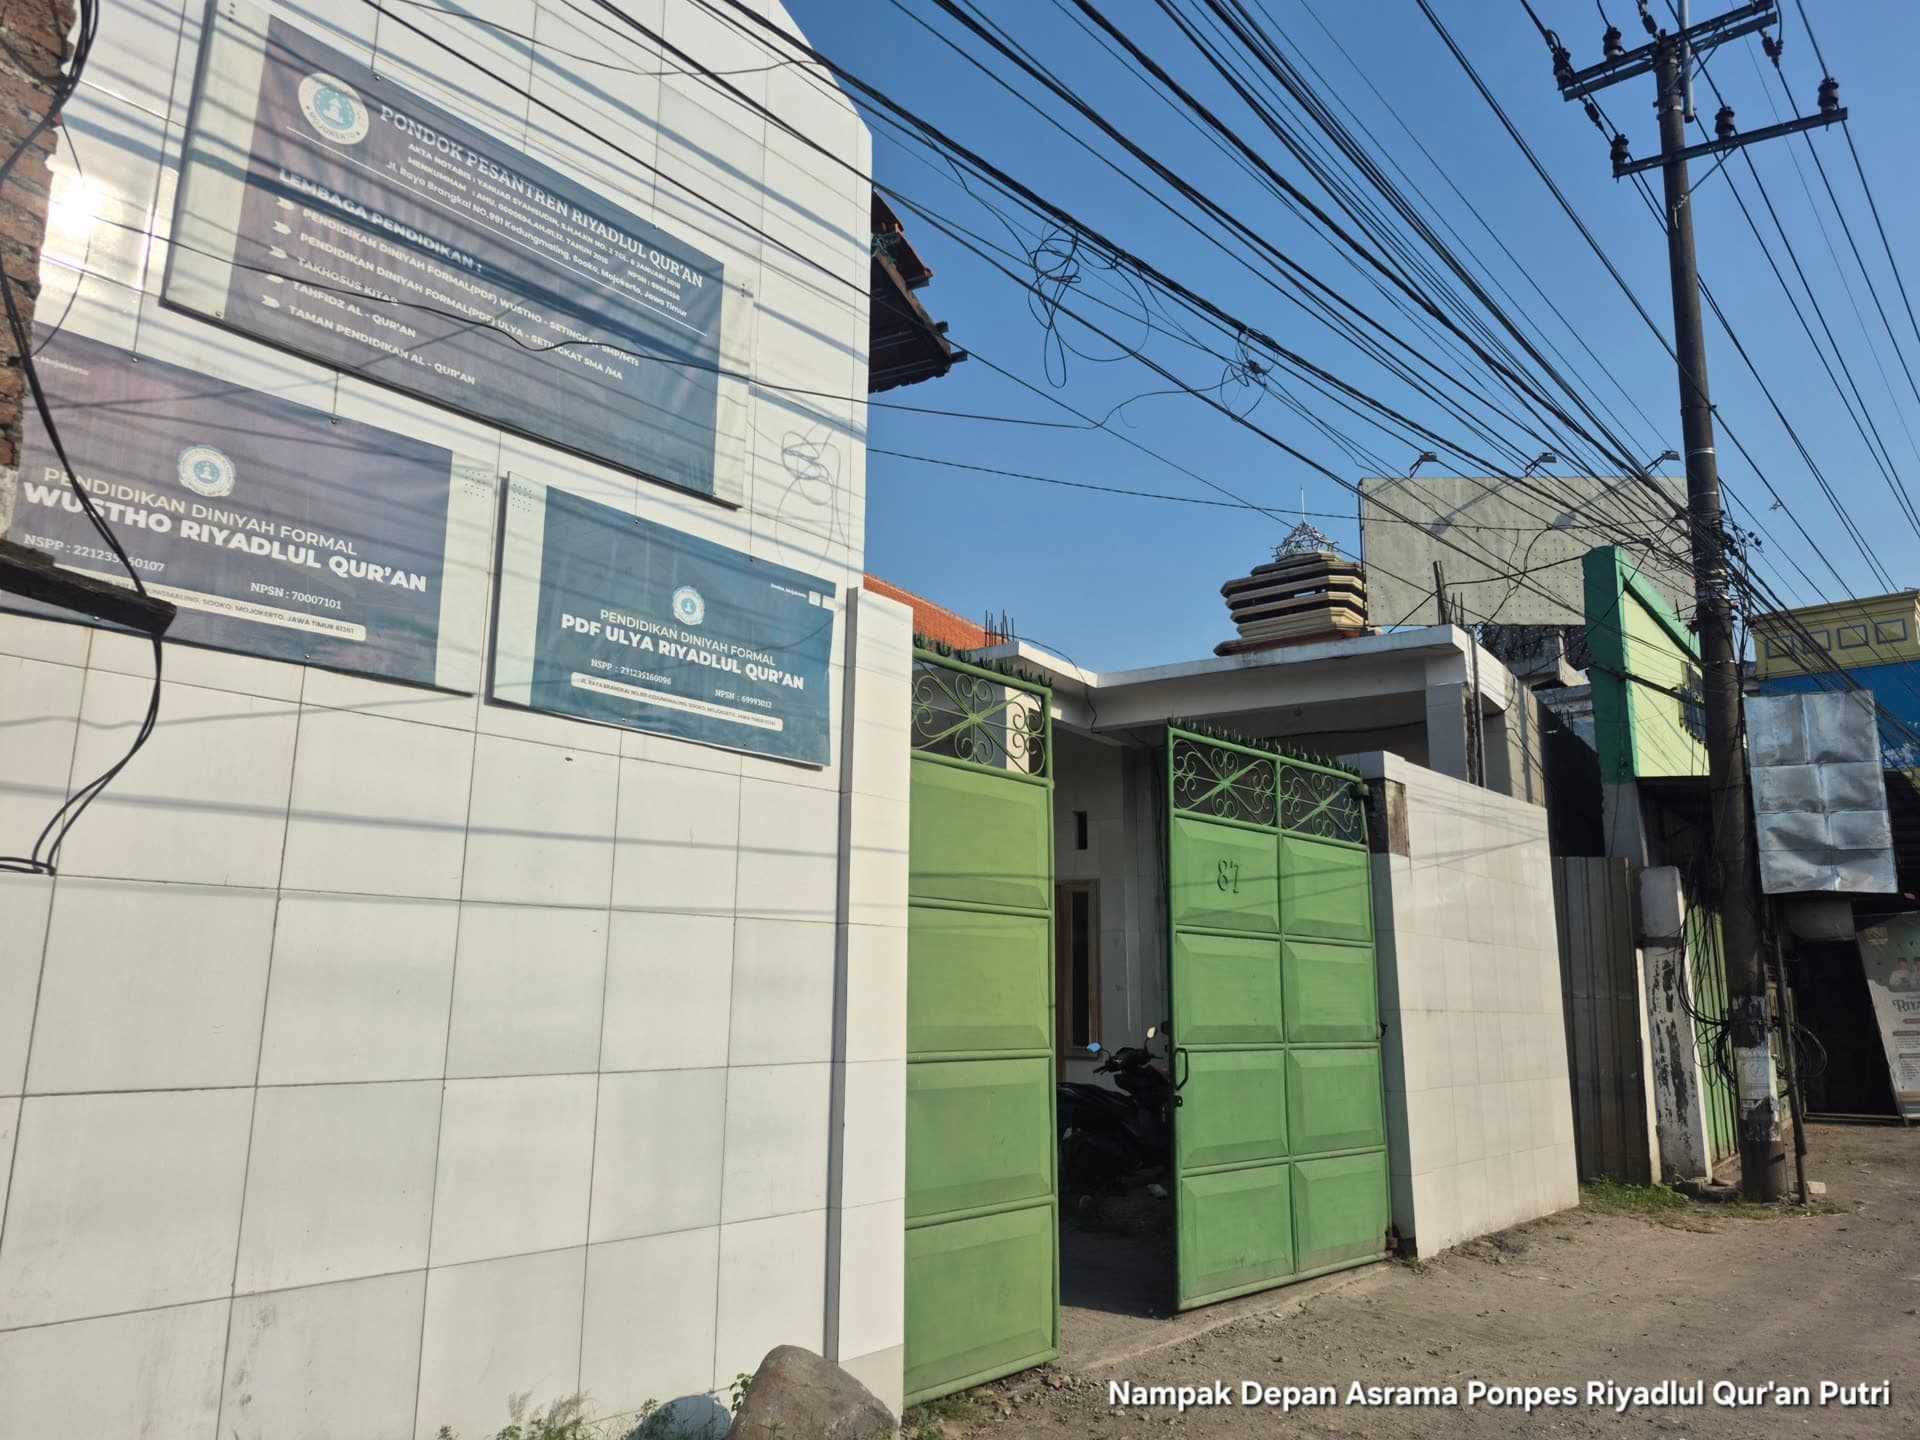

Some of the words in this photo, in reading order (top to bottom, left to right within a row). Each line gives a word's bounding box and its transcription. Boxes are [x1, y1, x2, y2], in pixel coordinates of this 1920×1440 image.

[380, 105, 463, 162] PONDOK
[465, 151, 569, 217] PESANTREN
[571, 207, 647, 259] RIYADLUL
[650, 250, 704, 289] QUR'AN
[408, 143, 433, 160] AKTA
[434, 156, 472, 180] NOTARIS
[477, 176, 511, 200] YANUAR
[408, 157, 467, 191] MENKUMHAM
[279, 168, 369, 220] LEMBAGA
[371, 213, 475, 268] PENDIDIKAN
[400, 167, 427, 187] Raya
[427, 180, 472, 209] Brangkal
[644, 291, 665, 307] Jawa
[666, 301, 687, 317] Timur
[297, 256, 363, 292] TAKHOSUS
[364, 285, 399, 306] KITAB
[303, 208, 377, 249] PENDIDIKAN
[379, 243, 426, 271] DINIYAH
[500, 297, 542, 322] WUSTHO
[292, 280, 346, 309] TAHFIDZ
[347, 303, 364, 316] AL
[372, 314, 416, 338] QUR'AN
[300, 232, 374, 272] PENDIDIKAN
[376, 266, 423, 293] DINIYAH
[497, 319, 523, 337] ULYA
[583, 357, 604, 372] SMA
[288, 305, 334, 330] TAMAN
[335, 324, 409, 359] PENDIDIKAN
[410, 354, 426, 366] AL
[434, 363, 476, 385] QUR'AN
[23, 482, 172, 533] WUSTHO
[180, 519, 322, 569] RIYADLUL
[328, 555, 427, 592] QUR'AN
[44, 467, 185, 514] PENDIDIKAN
[192, 503, 275, 536] DINIYAH
[280, 525, 358, 555] FORMAL
[24, 533, 64, 551] NSPP
[73, 544, 165, 572] 22123560107
[250, 582, 285, 598] NPSN
[291, 591, 342, 609] 70007101
[287, 616, 310, 626] JAWA
[561, 613, 602, 636] PDF
[605, 625, 655, 652] ULYA
[658, 639, 742, 674] RIYADLUL
[745, 663, 804, 690] QUR'AN
[591, 658, 613, 671] NSPP
[600, 609, 678, 640] PENDIDIKAN
[680, 631, 728, 653] DINIYAH
[730, 645, 776, 666] FORMAL
